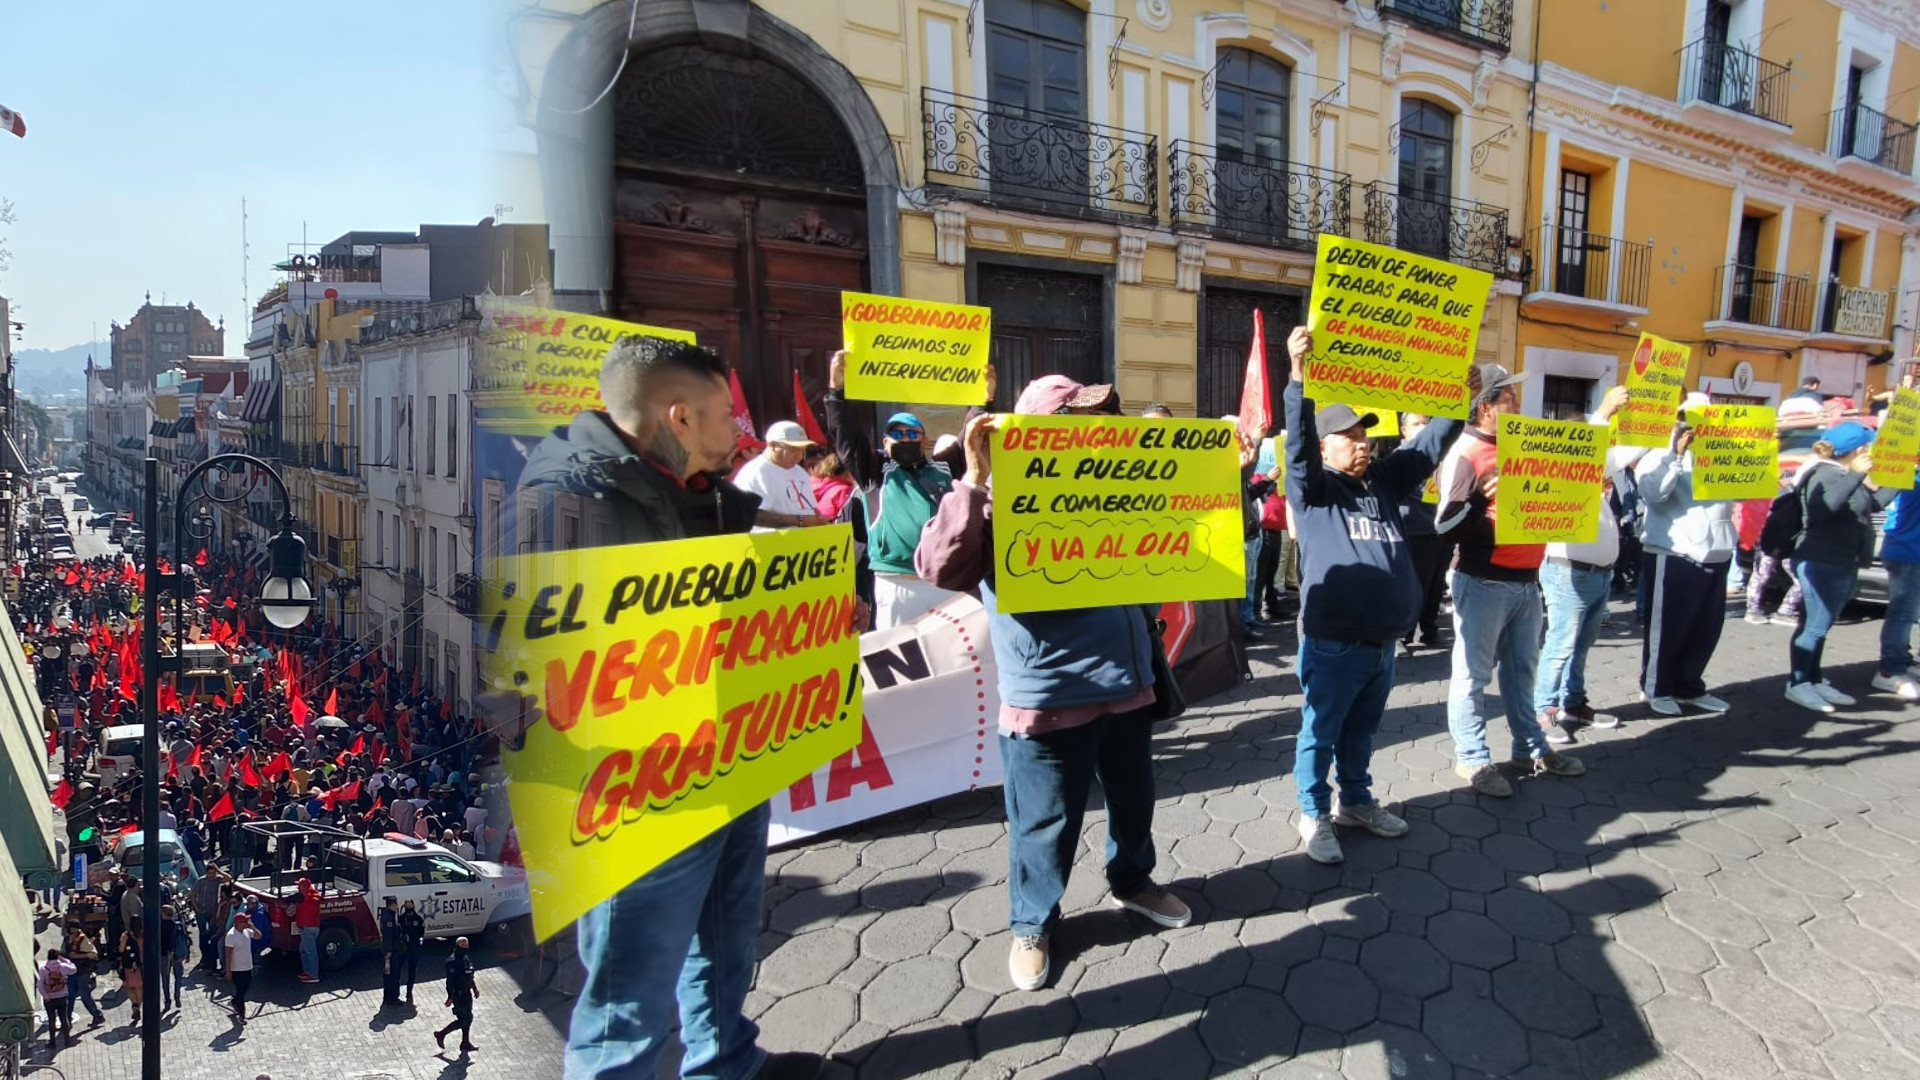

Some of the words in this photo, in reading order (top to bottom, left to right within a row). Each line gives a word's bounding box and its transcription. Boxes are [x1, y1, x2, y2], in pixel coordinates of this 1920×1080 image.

[1325, 246, 1383, 270] DEJEN
[1381, 258, 1407, 277] DE
[1406, 264, 1458, 292] PONER
[1327, 273, 1395, 299] TRABAS
[1397, 288, 1439, 310] PARA
[1443, 299, 1473, 318] QUE
[1320, 297, 1342, 314] EL
[1347, 302, 1413, 327] PUEBLO
[1415, 316, 1471, 343] TRABAJE
[872, 334, 947, 355] PEDIMOS
[949, 341, 971, 356] SU
[1325, 318, 1347, 335] DE
[1349, 323, 1405, 345] MANERA
[1407, 335, 1468, 360] HONRADA
[859, 360, 982, 385] INTERVENCION
[1309, 362, 1399, 391] VERIFICACION
[1403, 377, 1464, 401] GRATUITA
[1703, 408, 1720, 419] NO
[1723, 409, 1731, 418] A
[1734, 409, 1748, 418] LA
[1139, 428, 1165, 449] EL
[1171, 428, 1232, 450] ROBO
[1506, 421, 1522, 435] SE
[1523, 423, 1566, 439] SUMAN
[1568, 427, 1595, 442] LOS
[1520, 440, 1597, 458] COMERCIANTES
[1705, 440, 1758, 450] VEHICULAR
[1025, 457, 1061, 479] AL
[1073, 458, 1178, 481] PUEBLO
[1501, 457, 1604, 484] ANTORCHISTAS
[1696, 455, 1710, 468] NO
[1712, 455, 1732, 467] MAS
[1735, 455, 1771, 467] ABUSOS
[1522, 480, 1531, 493] A
[1703, 473, 1715, 484] AL
[1011, 495, 1040, 514] EL
[1050, 493, 1167, 512] COMERCIO
[1169, 492, 1240, 511] TRABAJA
[1520, 500, 1584, 513] VERIFICACION
[1523, 516, 1574, 531] GRATUITA
[1025, 538, 1041, 567] Y
[1051, 536, 1085, 562] VA
[1095, 533, 1128, 560] AL
[1134, 531, 1191, 557] DIA
[603, 557, 757, 624] PUEBLO
[443, 897, 485, 915] ESTATAL
